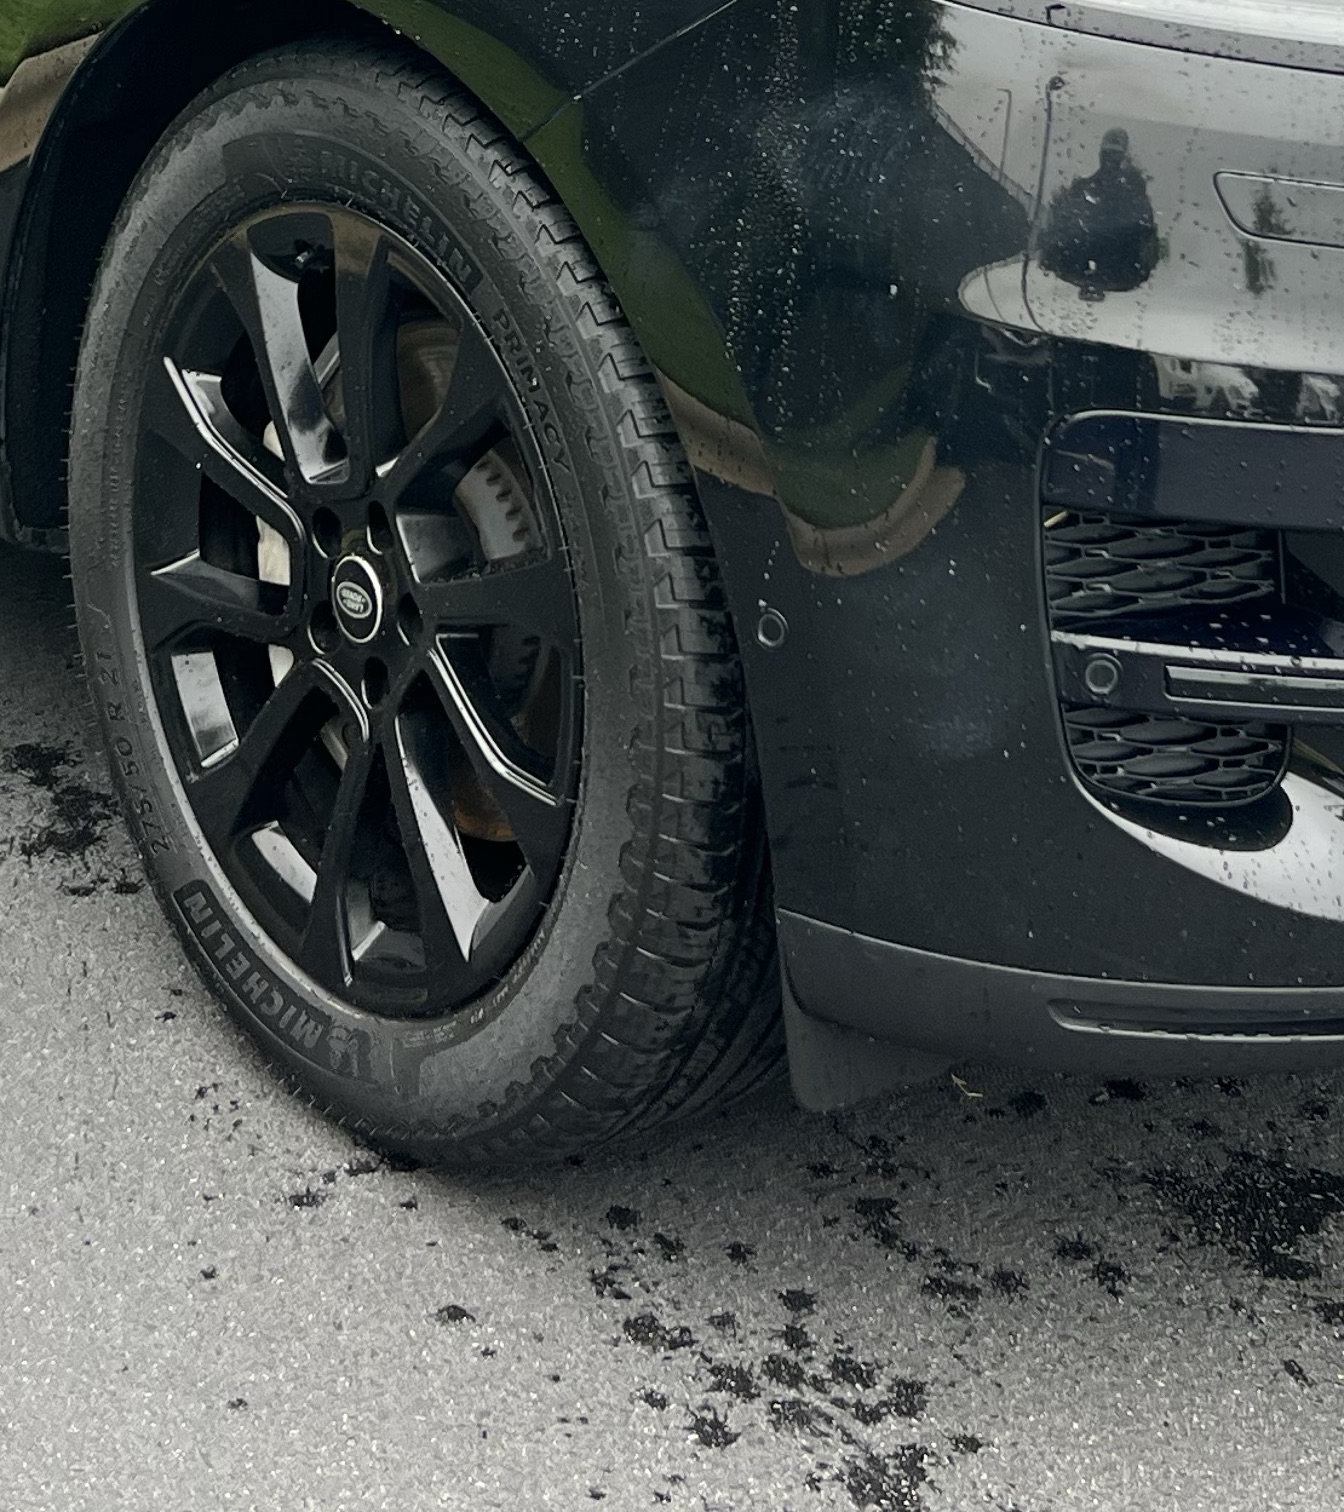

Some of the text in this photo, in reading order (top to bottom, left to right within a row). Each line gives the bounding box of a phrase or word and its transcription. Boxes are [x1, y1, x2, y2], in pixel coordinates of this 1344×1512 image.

[320, 150, 472, 283] MICHELIN
[492, 308, 571, 473] PRIMACY
[184, 890, 323, 1049] MICHELIN
